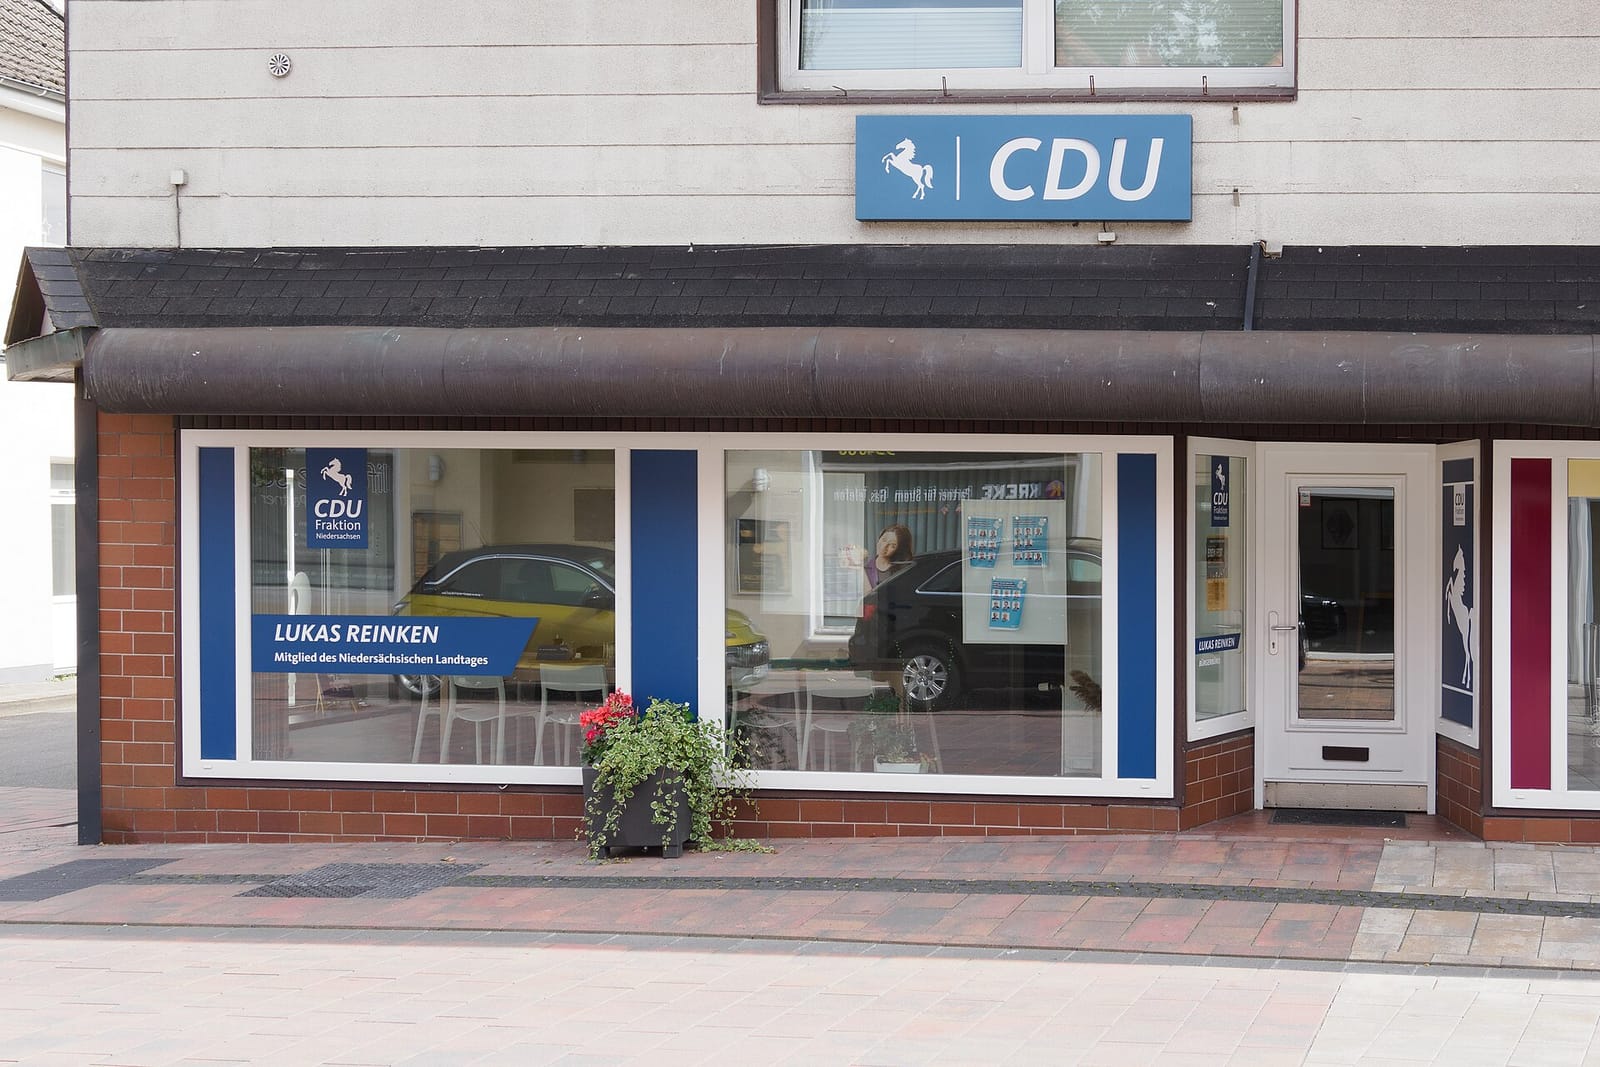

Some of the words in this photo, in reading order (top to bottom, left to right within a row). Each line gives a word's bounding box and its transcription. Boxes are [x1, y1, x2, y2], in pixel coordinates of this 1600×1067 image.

[989, 137, 1164, 201] CDU
[1213, 492, 1228, 505] CDU
[314, 499, 363, 518] CDU
[315, 519, 361, 531] Fraktion
[316, 532, 361, 540] Niedersachsen
[274, 624, 341, 643] LUKAS
[346, 625, 439, 643] REINKEN
[1199, 639, 1214, 651] LUKAS
[1214, 637, 1235, 649] REINKEN
[274, 651, 317, 664] Mitglied
[319, 652, 337, 663] des
[339, 652, 433, 665] Niedersächsischen
[435, 654, 488, 667] Landtages
